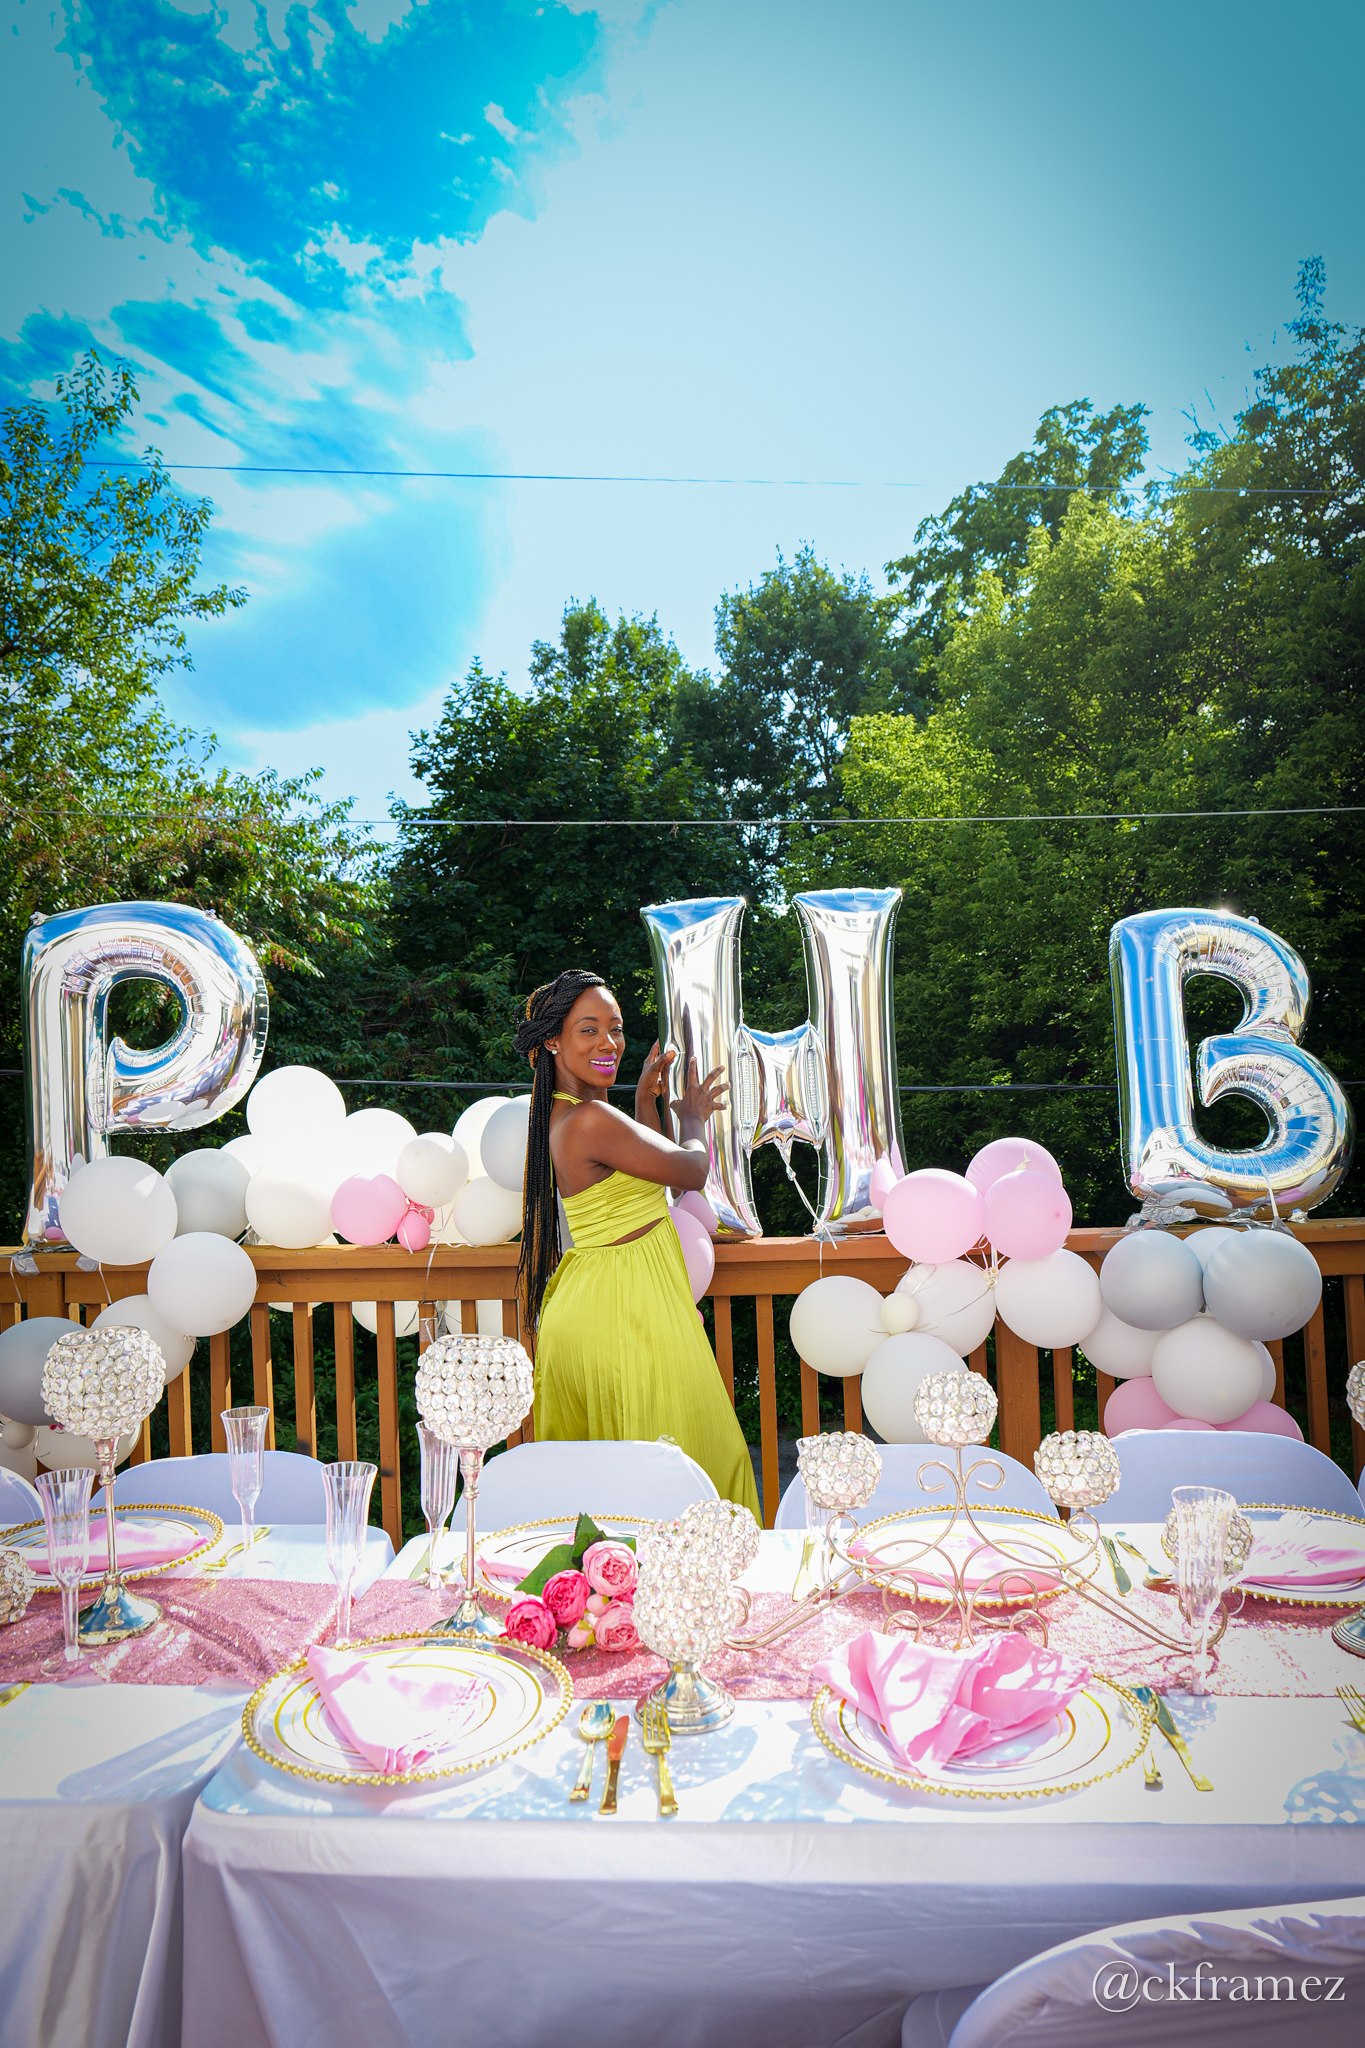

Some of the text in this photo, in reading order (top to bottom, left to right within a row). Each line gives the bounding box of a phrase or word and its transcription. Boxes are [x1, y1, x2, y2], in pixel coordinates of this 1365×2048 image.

[22, 887, 1355, 1245] P H B
